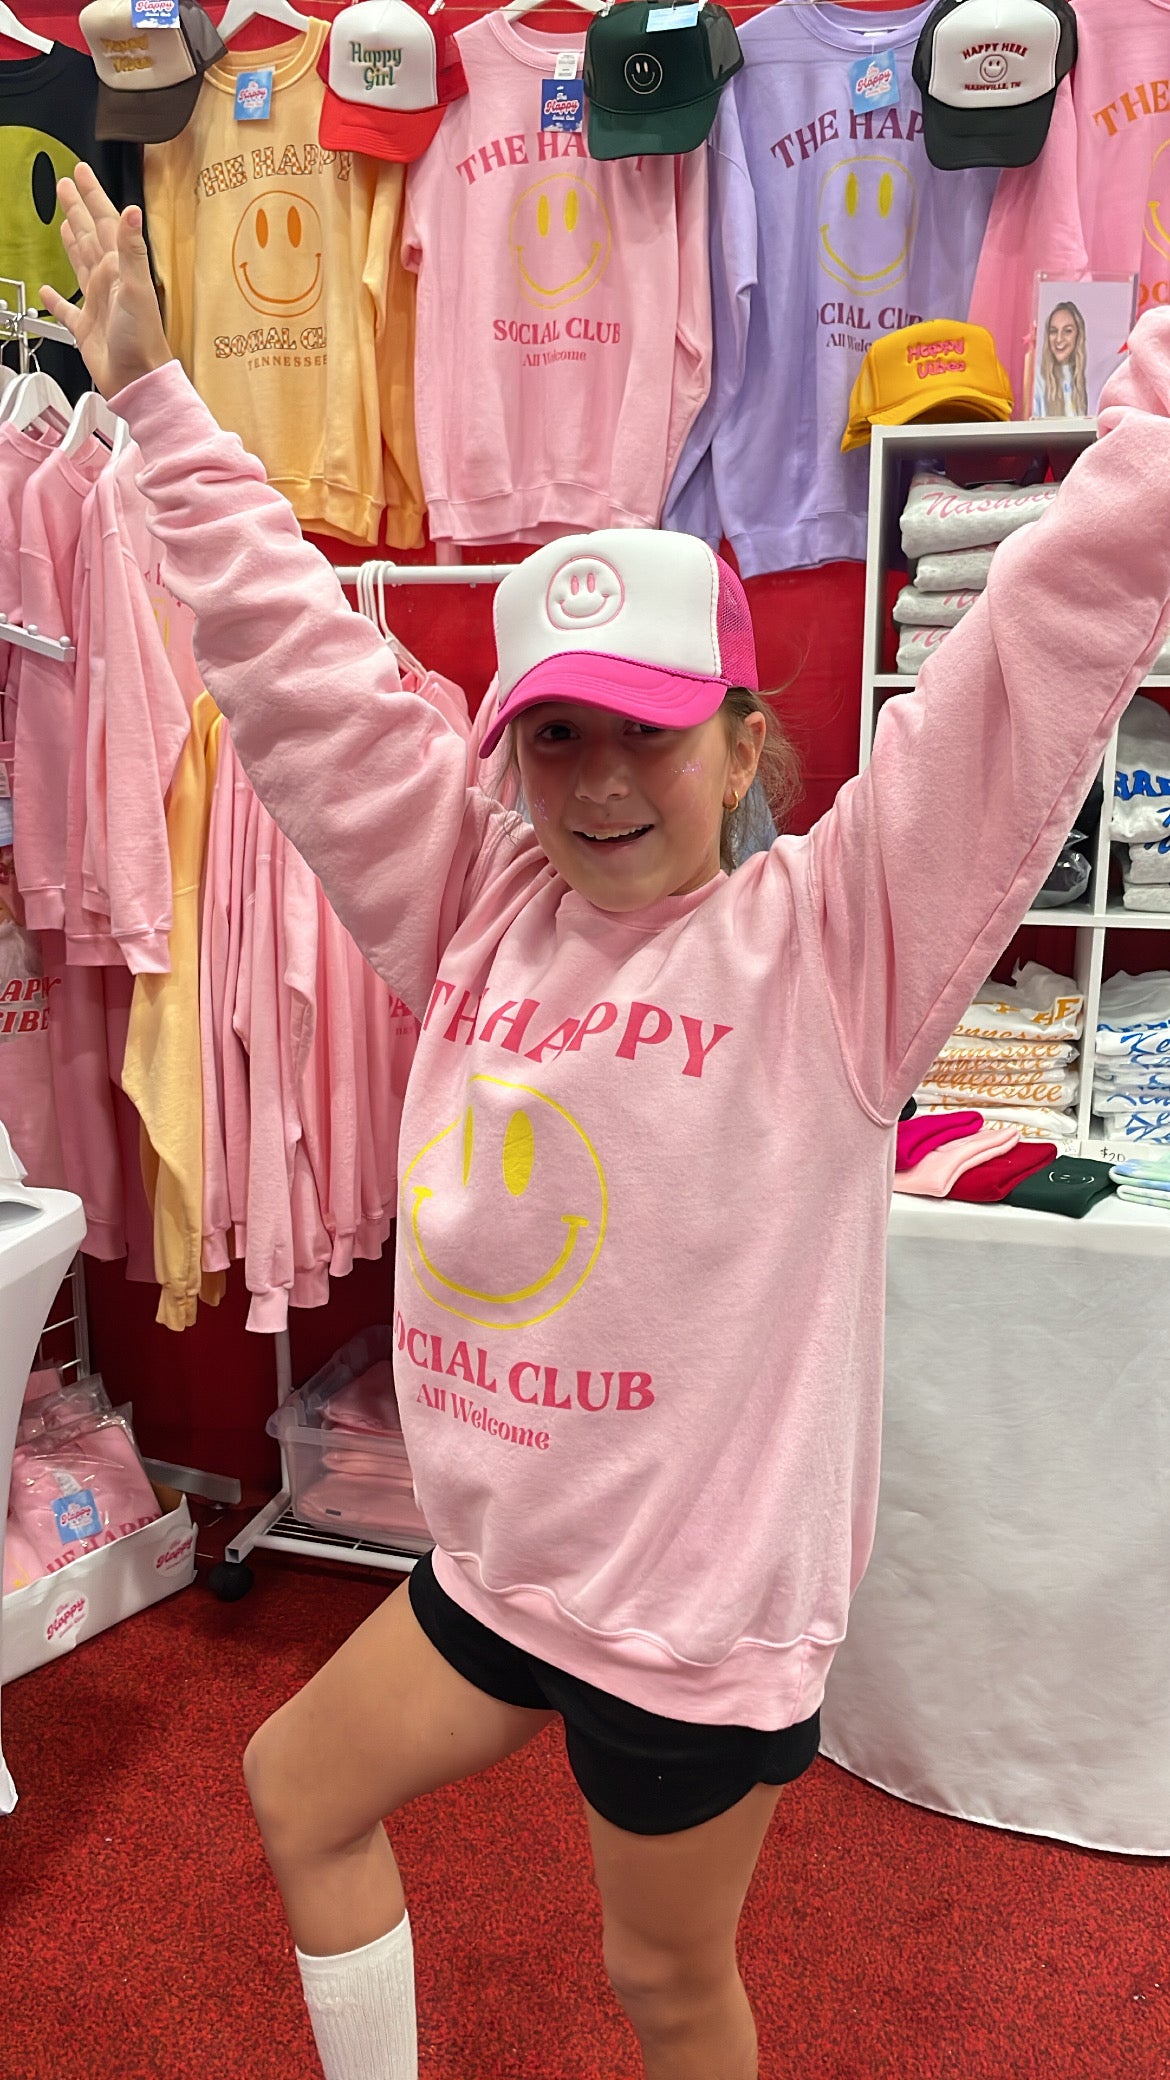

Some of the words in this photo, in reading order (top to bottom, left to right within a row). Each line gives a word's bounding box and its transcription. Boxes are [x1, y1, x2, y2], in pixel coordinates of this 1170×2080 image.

[349, 41, 402, 68] Happy
[962, 43, 999, 60] HAPPY
[1001, 43, 1028, 57] HERE
[364, 66, 395, 91] Girl
[857, 70, 891, 92] Happy
[545, 100, 579, 113] Happy
[1092, 80, 1170, 137] THE
[770, 109, 839, 168] THE
[849, 108, 925, 142] HAP
[196, 154, 247, 197] HE
[456, 134, 529, 185] THE
[493, 319, 560, 345] SOCIAL
[565, 317, 620, 344] CLUB
[826, 333, 845, 348] All
[248, 354, 328, 371] TENNESSEE
[479, 998, 734, 1078] HAPPY
[508, 1361, 655, 1412] CLUB
[416, 1383, 447, 1412] All
[450, 1392, 550, 1450] Welcome
[156, 1536, 193, 1569] Happy
[47, 1597, 86, 1641] Happy
